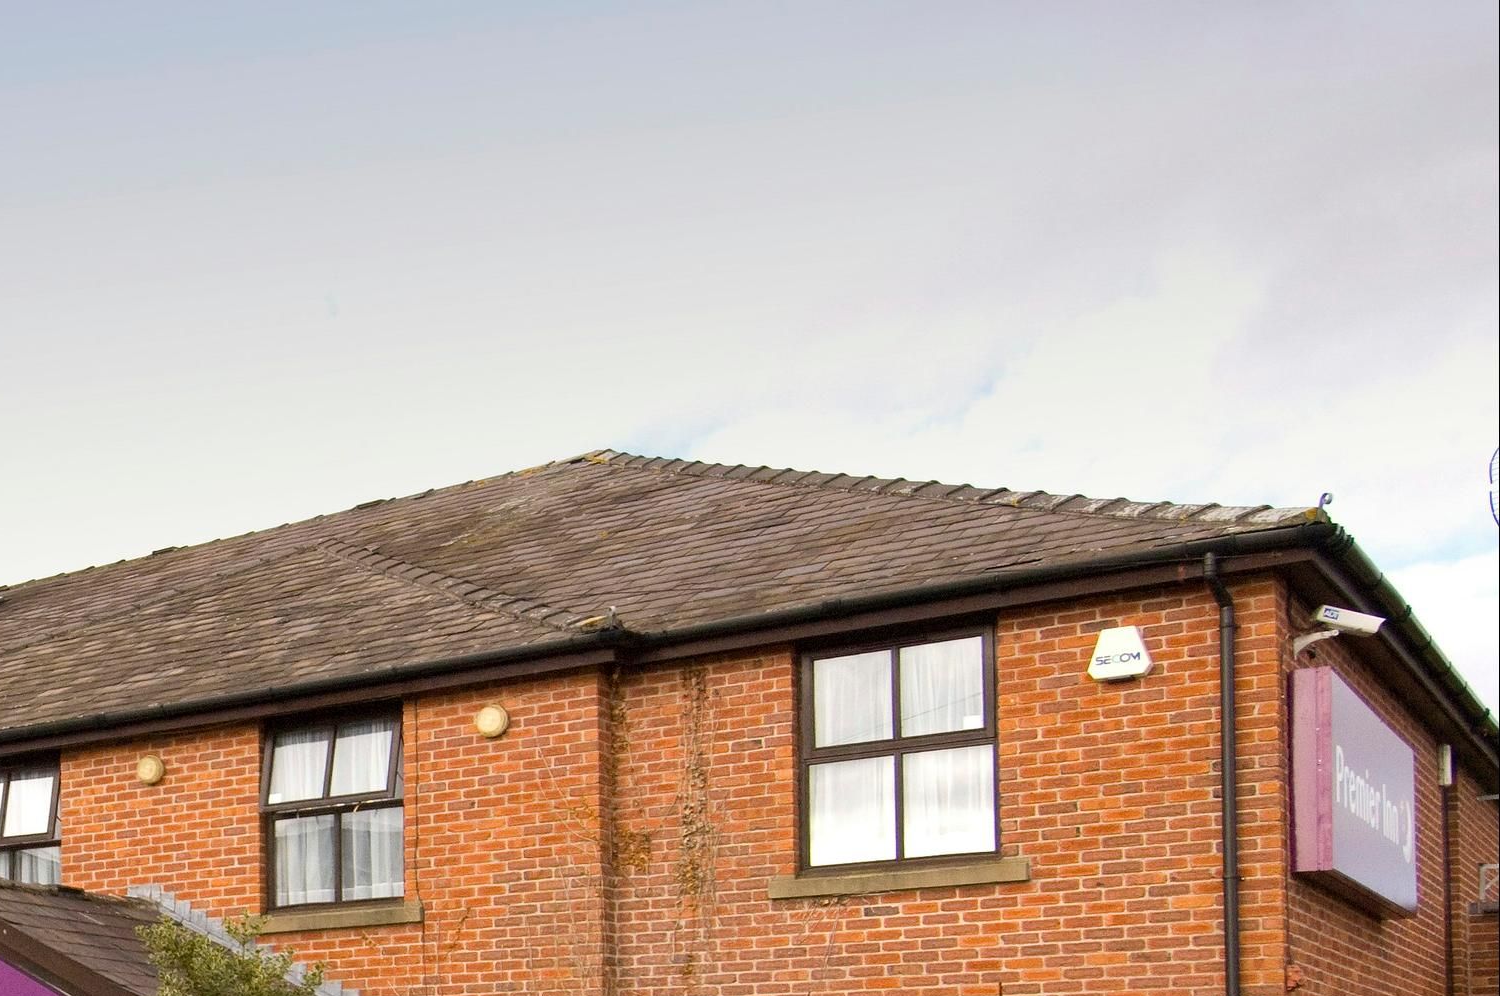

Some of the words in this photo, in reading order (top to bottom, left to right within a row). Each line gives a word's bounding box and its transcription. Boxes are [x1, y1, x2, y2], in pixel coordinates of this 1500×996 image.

[1095, 652, 1141, 666] SECOM
[1335, 744, 1381, 831] Premier
[1382, 783, 1400, 845] Inn
